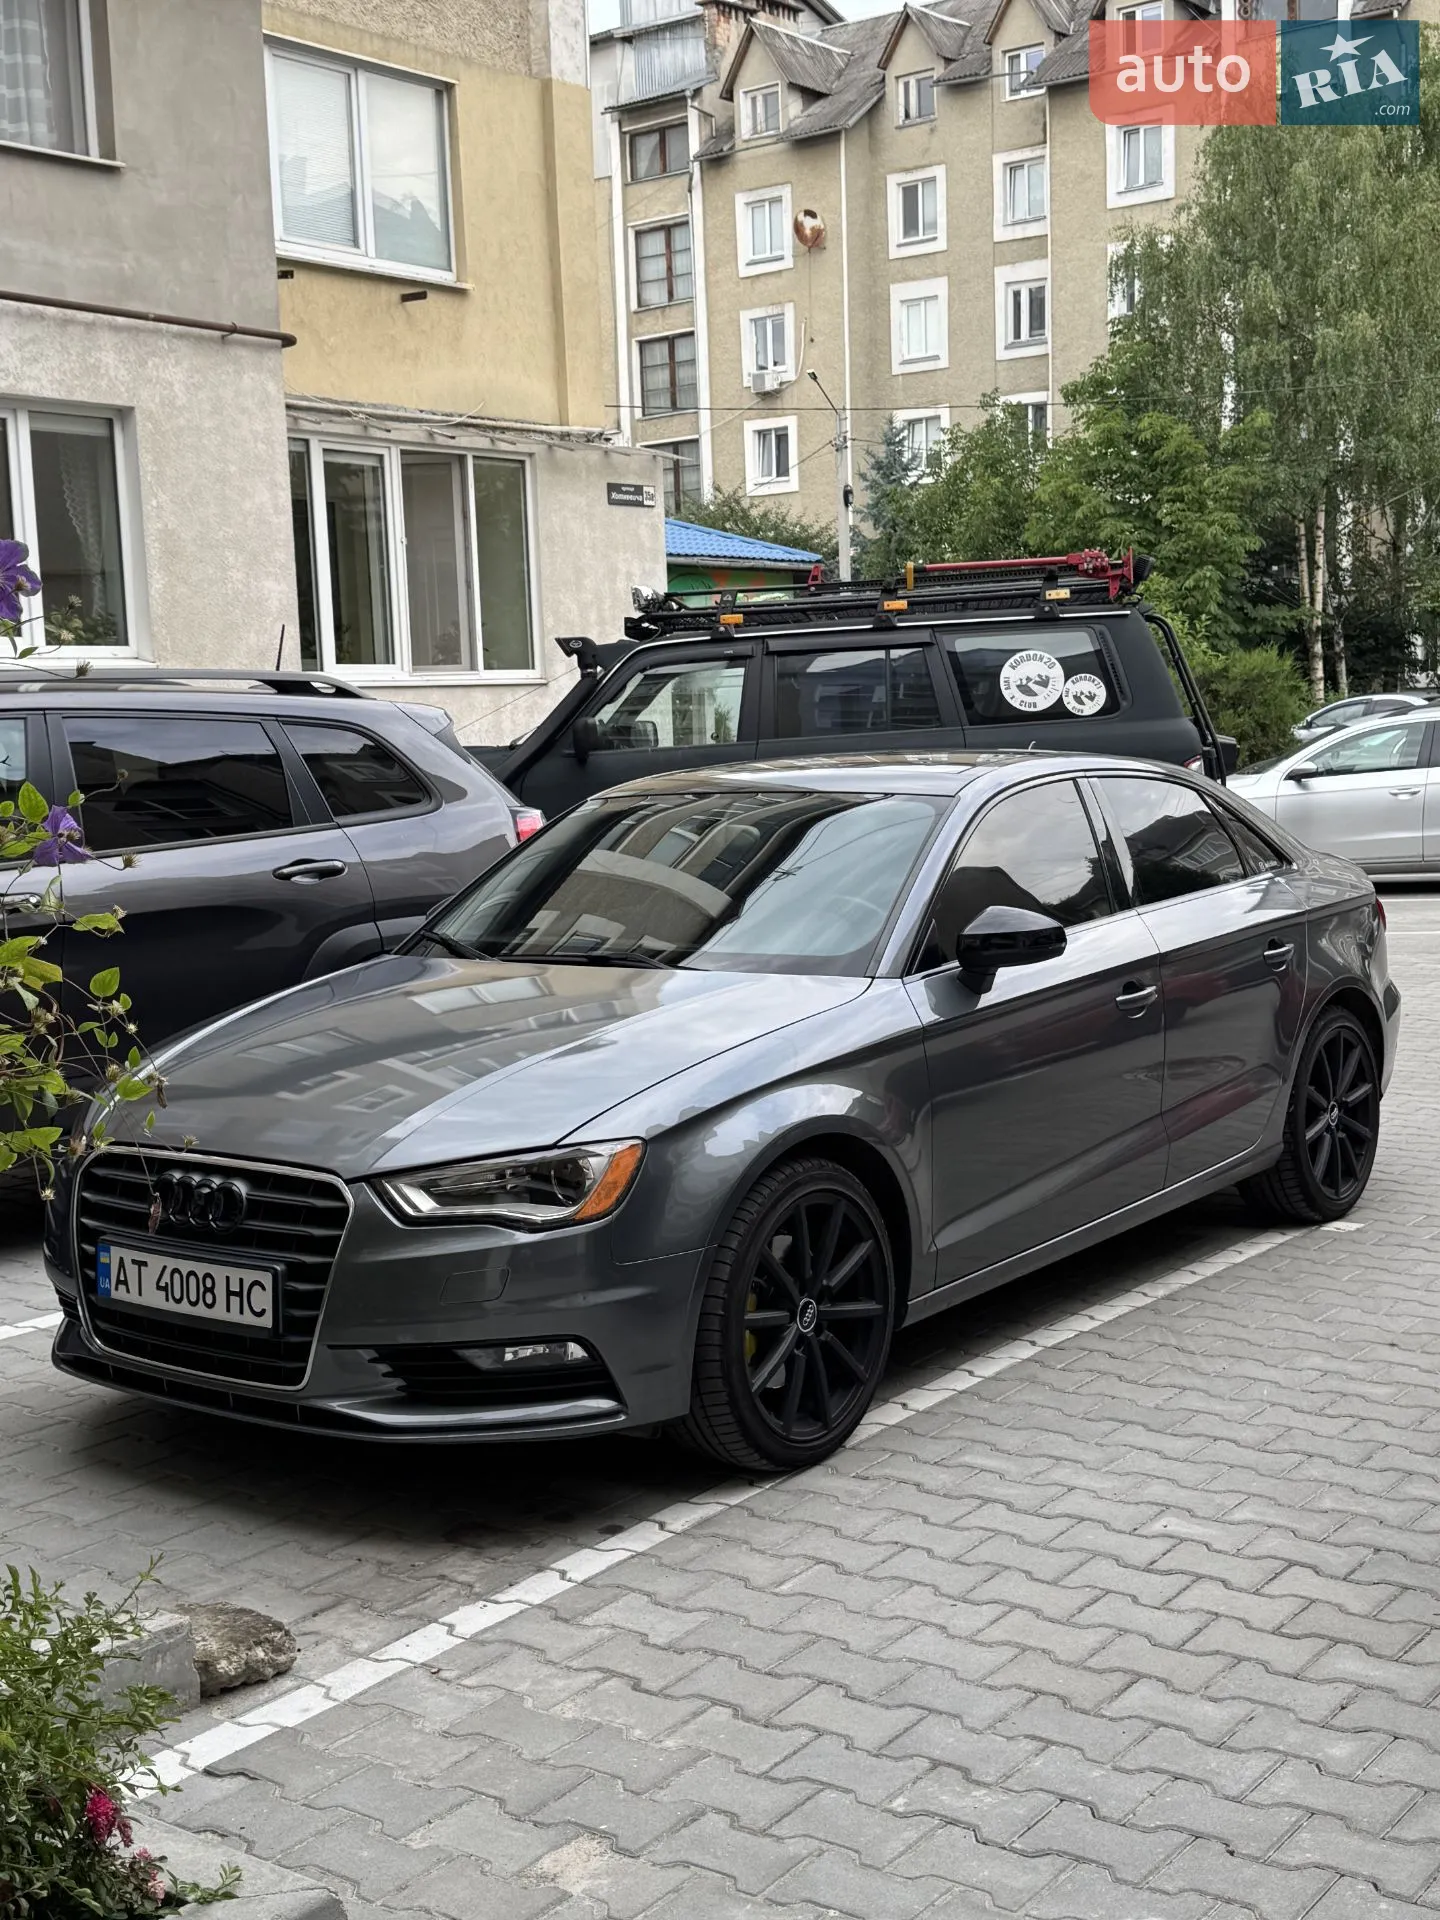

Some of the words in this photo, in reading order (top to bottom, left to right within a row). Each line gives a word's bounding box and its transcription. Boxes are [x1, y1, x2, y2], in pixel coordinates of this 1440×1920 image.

[1019, 700, 1038, 709] CLUB
[100, 1276, 110, 1289] UA
[115, 1256, 148, 1297] AT
[156, 1265, 217, 1310] 4008
[226, 1275, 267, 1318] HC
